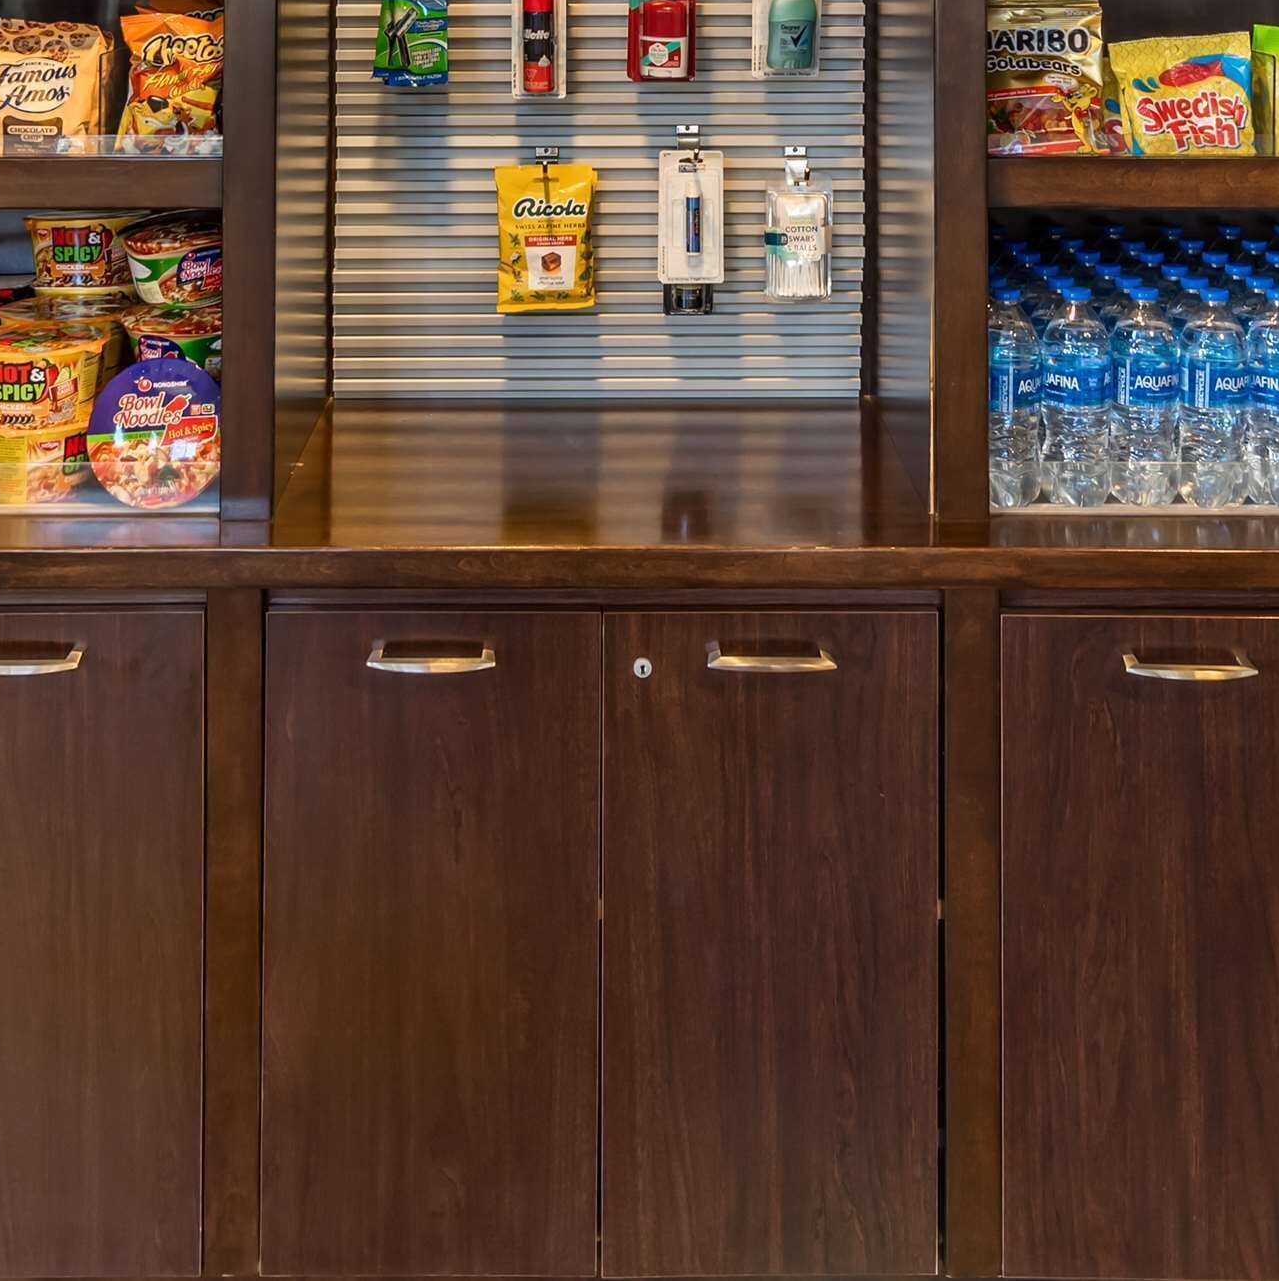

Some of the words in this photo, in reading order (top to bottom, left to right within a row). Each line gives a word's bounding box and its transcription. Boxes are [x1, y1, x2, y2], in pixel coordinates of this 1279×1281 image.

[987, 57, 1081, 75] Goldbears
[1137, 92, 1244, 132] Swedish
[1166, 118, 1237, 149] Fish
[514, 197, 586, 218] Ricola
[52, 228, 88, 245] HOT
[88, 232, 101, 244] &
[54, 246, 100, 262] SPICY
[30, 368, 45, 382] &
[119, 392, 165, 410] Bowl
[114, 409, 182, 427] Noodles
[168, 428, 183, 439] Hot
[184, 426, 191, 435] &
[192, 422, 214, 435] Spicy
